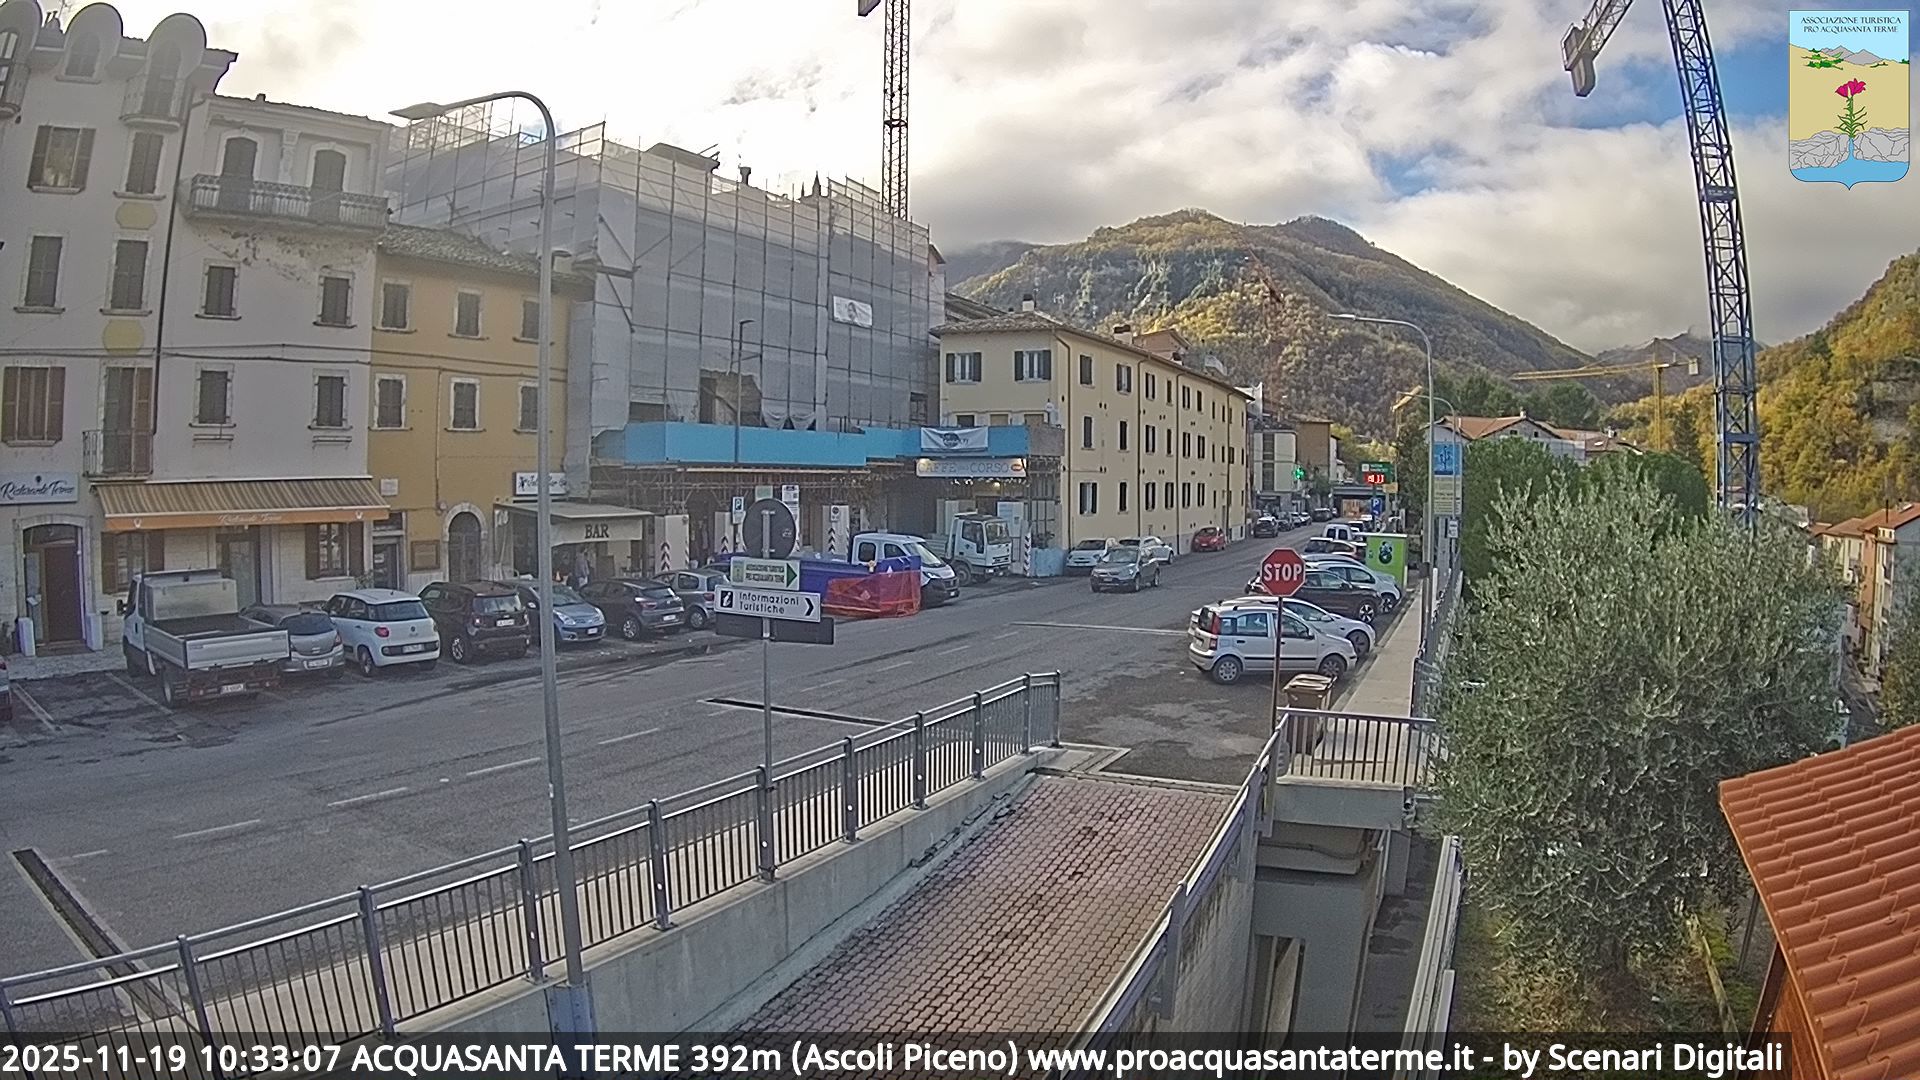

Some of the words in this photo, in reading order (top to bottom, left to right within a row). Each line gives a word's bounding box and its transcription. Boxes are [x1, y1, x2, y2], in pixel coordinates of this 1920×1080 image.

[970, 462, 1009, 473] CORSO
[585, 523, 609, 539] BAR
[1264, 563, 1302, 581] STOP
[740, 592, 799, 606] Informazioni
[740, 601, 785, 614] Turistiche
